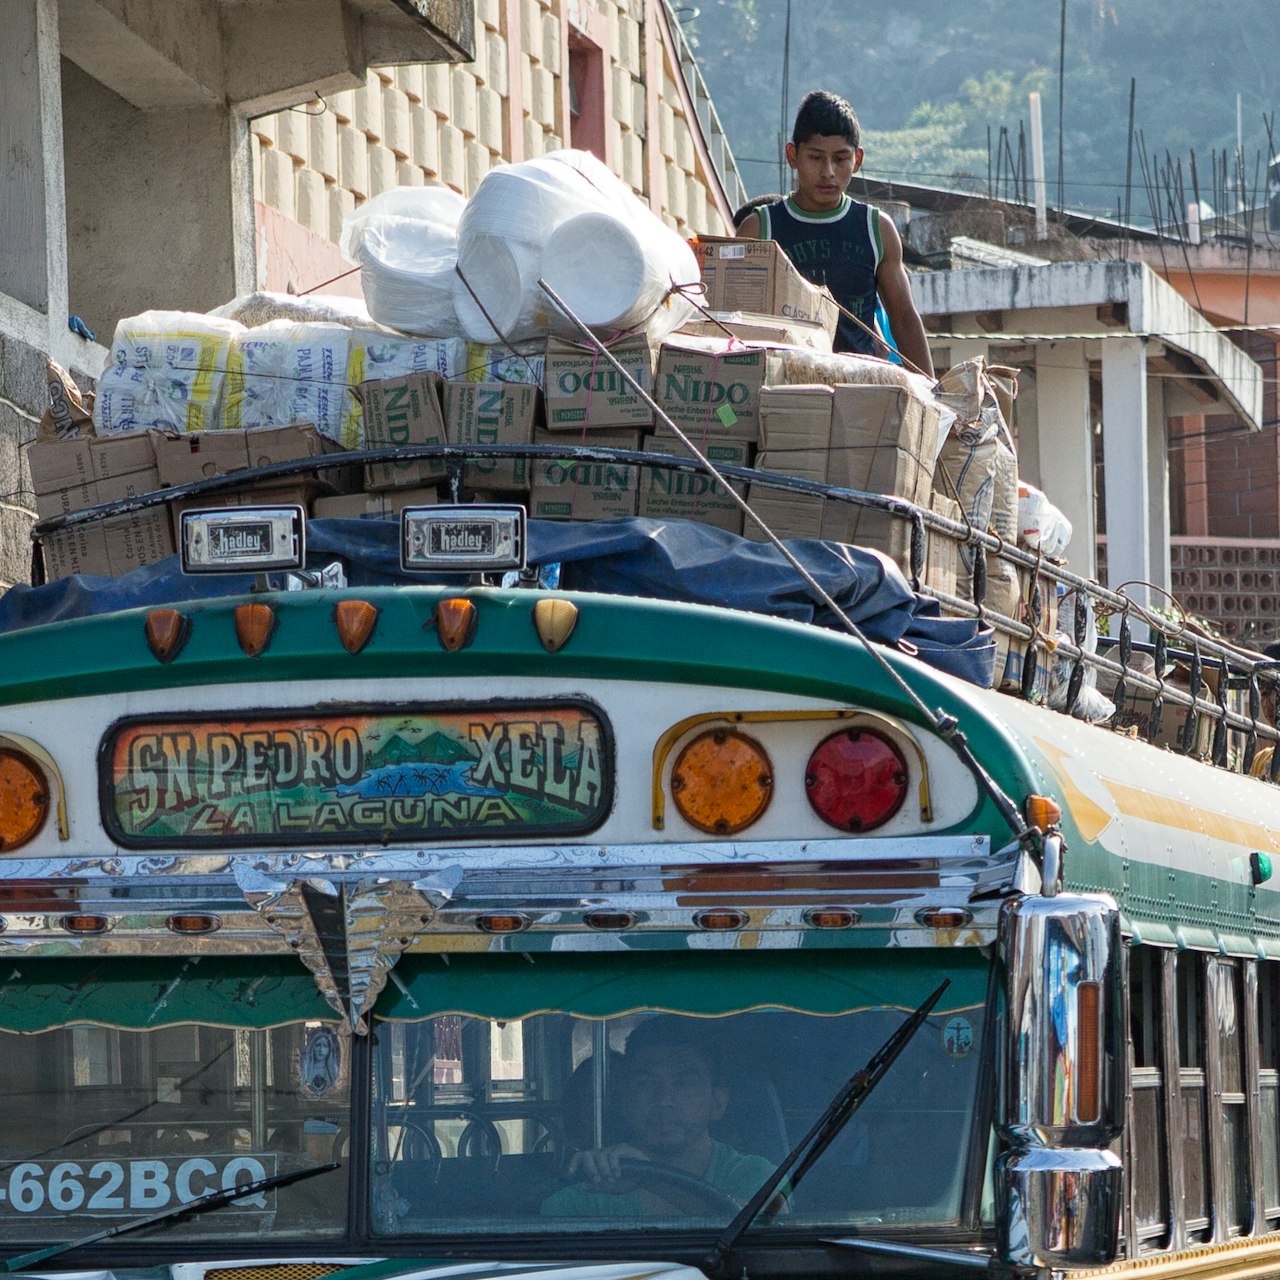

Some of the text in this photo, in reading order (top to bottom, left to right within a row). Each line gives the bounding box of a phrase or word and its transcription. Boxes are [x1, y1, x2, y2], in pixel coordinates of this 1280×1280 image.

[557, 368, 644, 398] NIDO
[663, 373, 751, 405] NIDO
[545, 463, 630, 493] NIDO
[219, 527, 261, 551] hadley
[440, 528, 483, 551] hadley
[469, 720, 604, 807] XELA
[192, 796, 521, 833] LA LAGUNA
